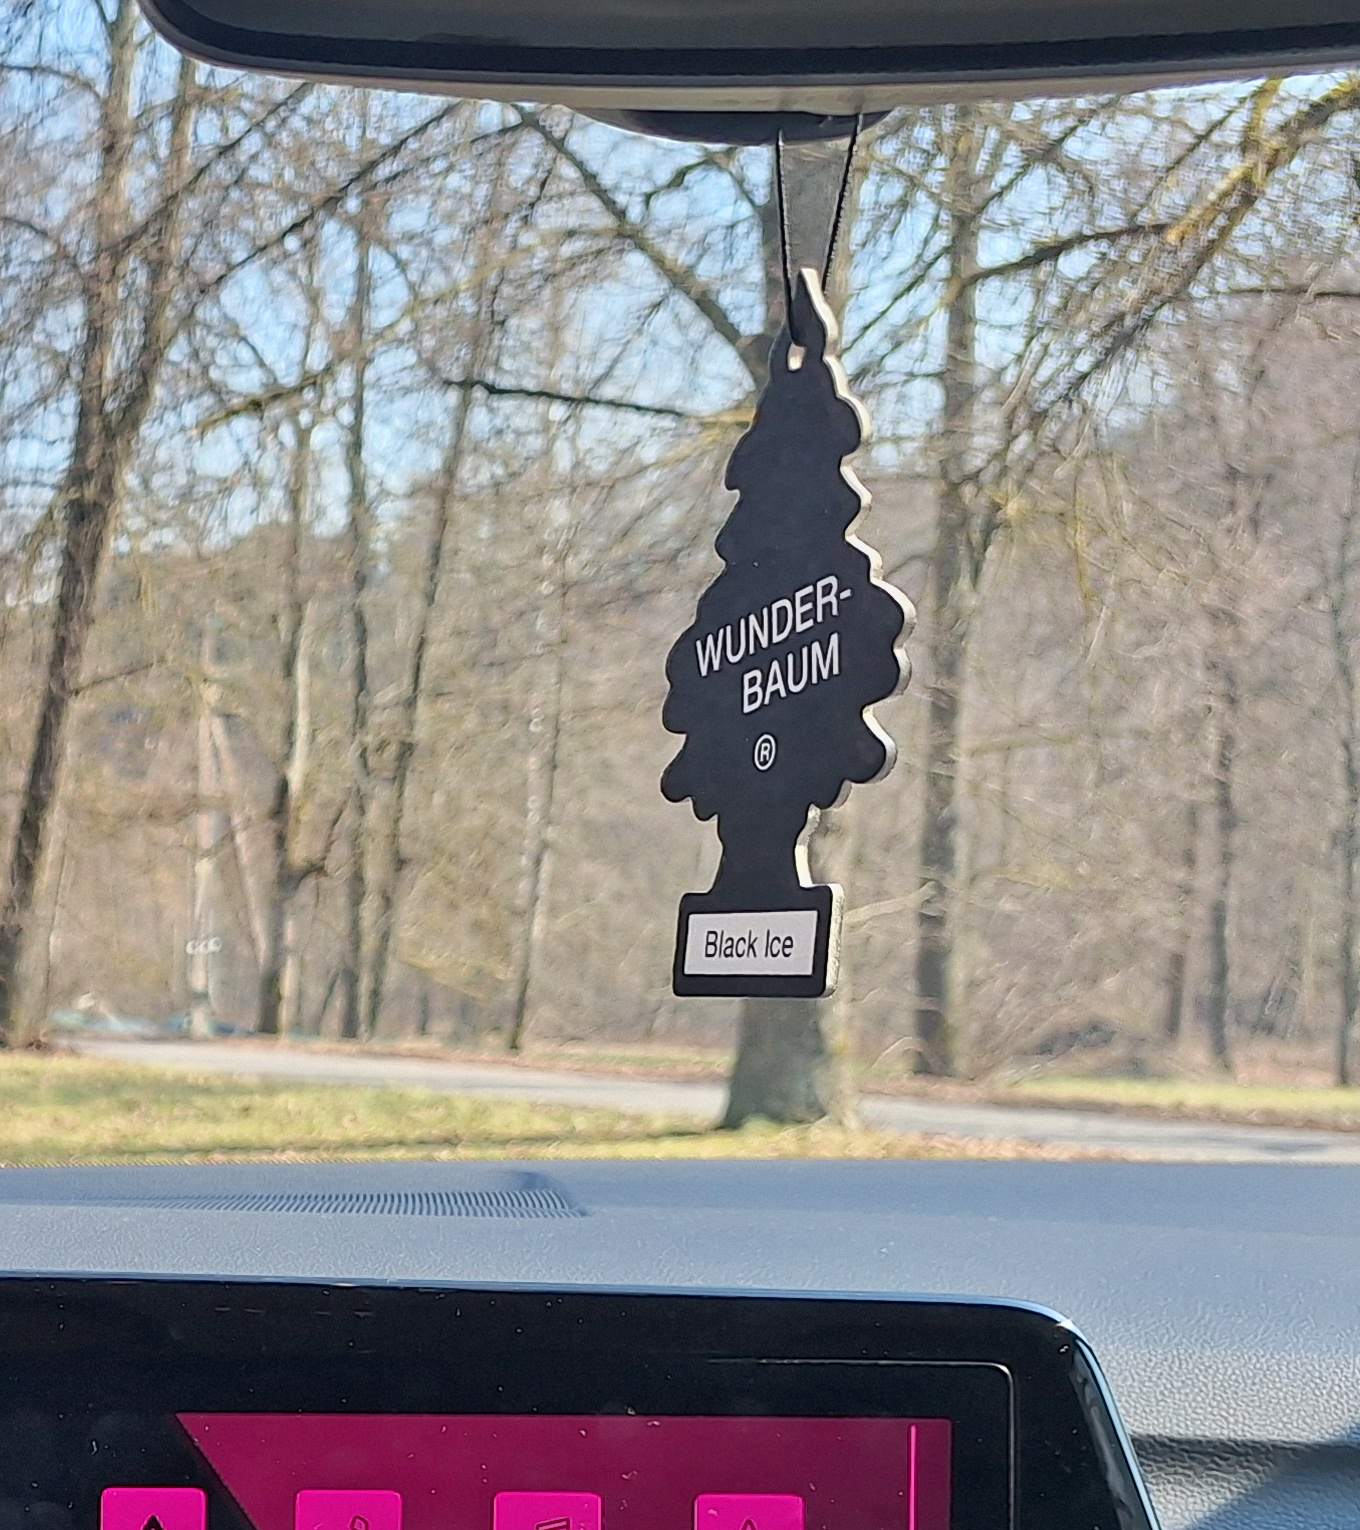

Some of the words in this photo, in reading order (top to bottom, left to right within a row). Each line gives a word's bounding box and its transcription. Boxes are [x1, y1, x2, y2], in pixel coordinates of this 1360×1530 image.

[696, 575, 851, 677] WUNDER-
[742, 632, 840, 714] BAUM
[705, 930, 757, 958] Black
[765, 929, 794, 958] Ice
